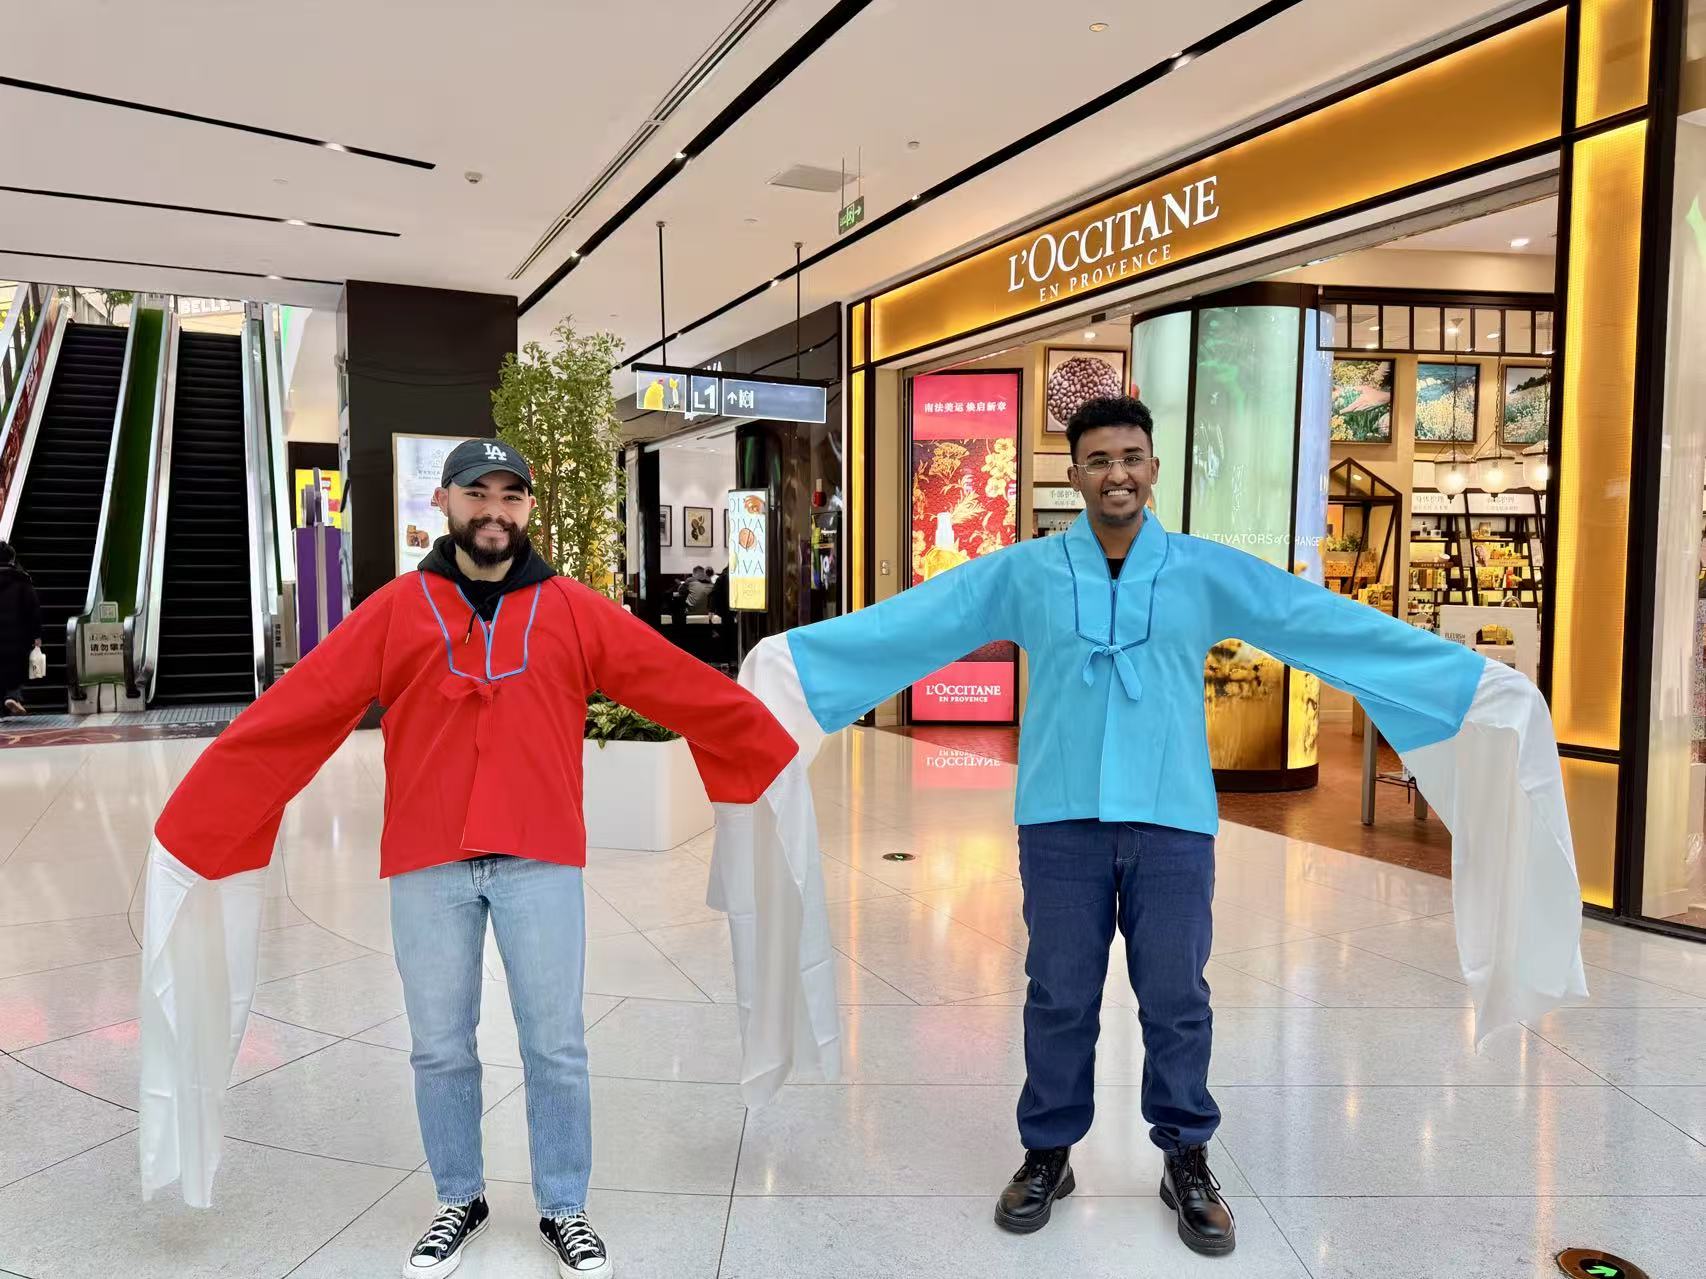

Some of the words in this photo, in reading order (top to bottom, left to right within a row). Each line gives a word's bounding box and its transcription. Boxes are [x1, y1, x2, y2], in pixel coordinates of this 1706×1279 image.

[1007, 175, 1220, 293] L'OCCITANE
[1039, 283, 1060, 303] EN
[1069, 243, 1173, 291] PROVENCE
[694, 384, 716, 410] L1
[483, 443, 507, 461] LA
[926, 683, 1001, 695] L'OCCITANE
